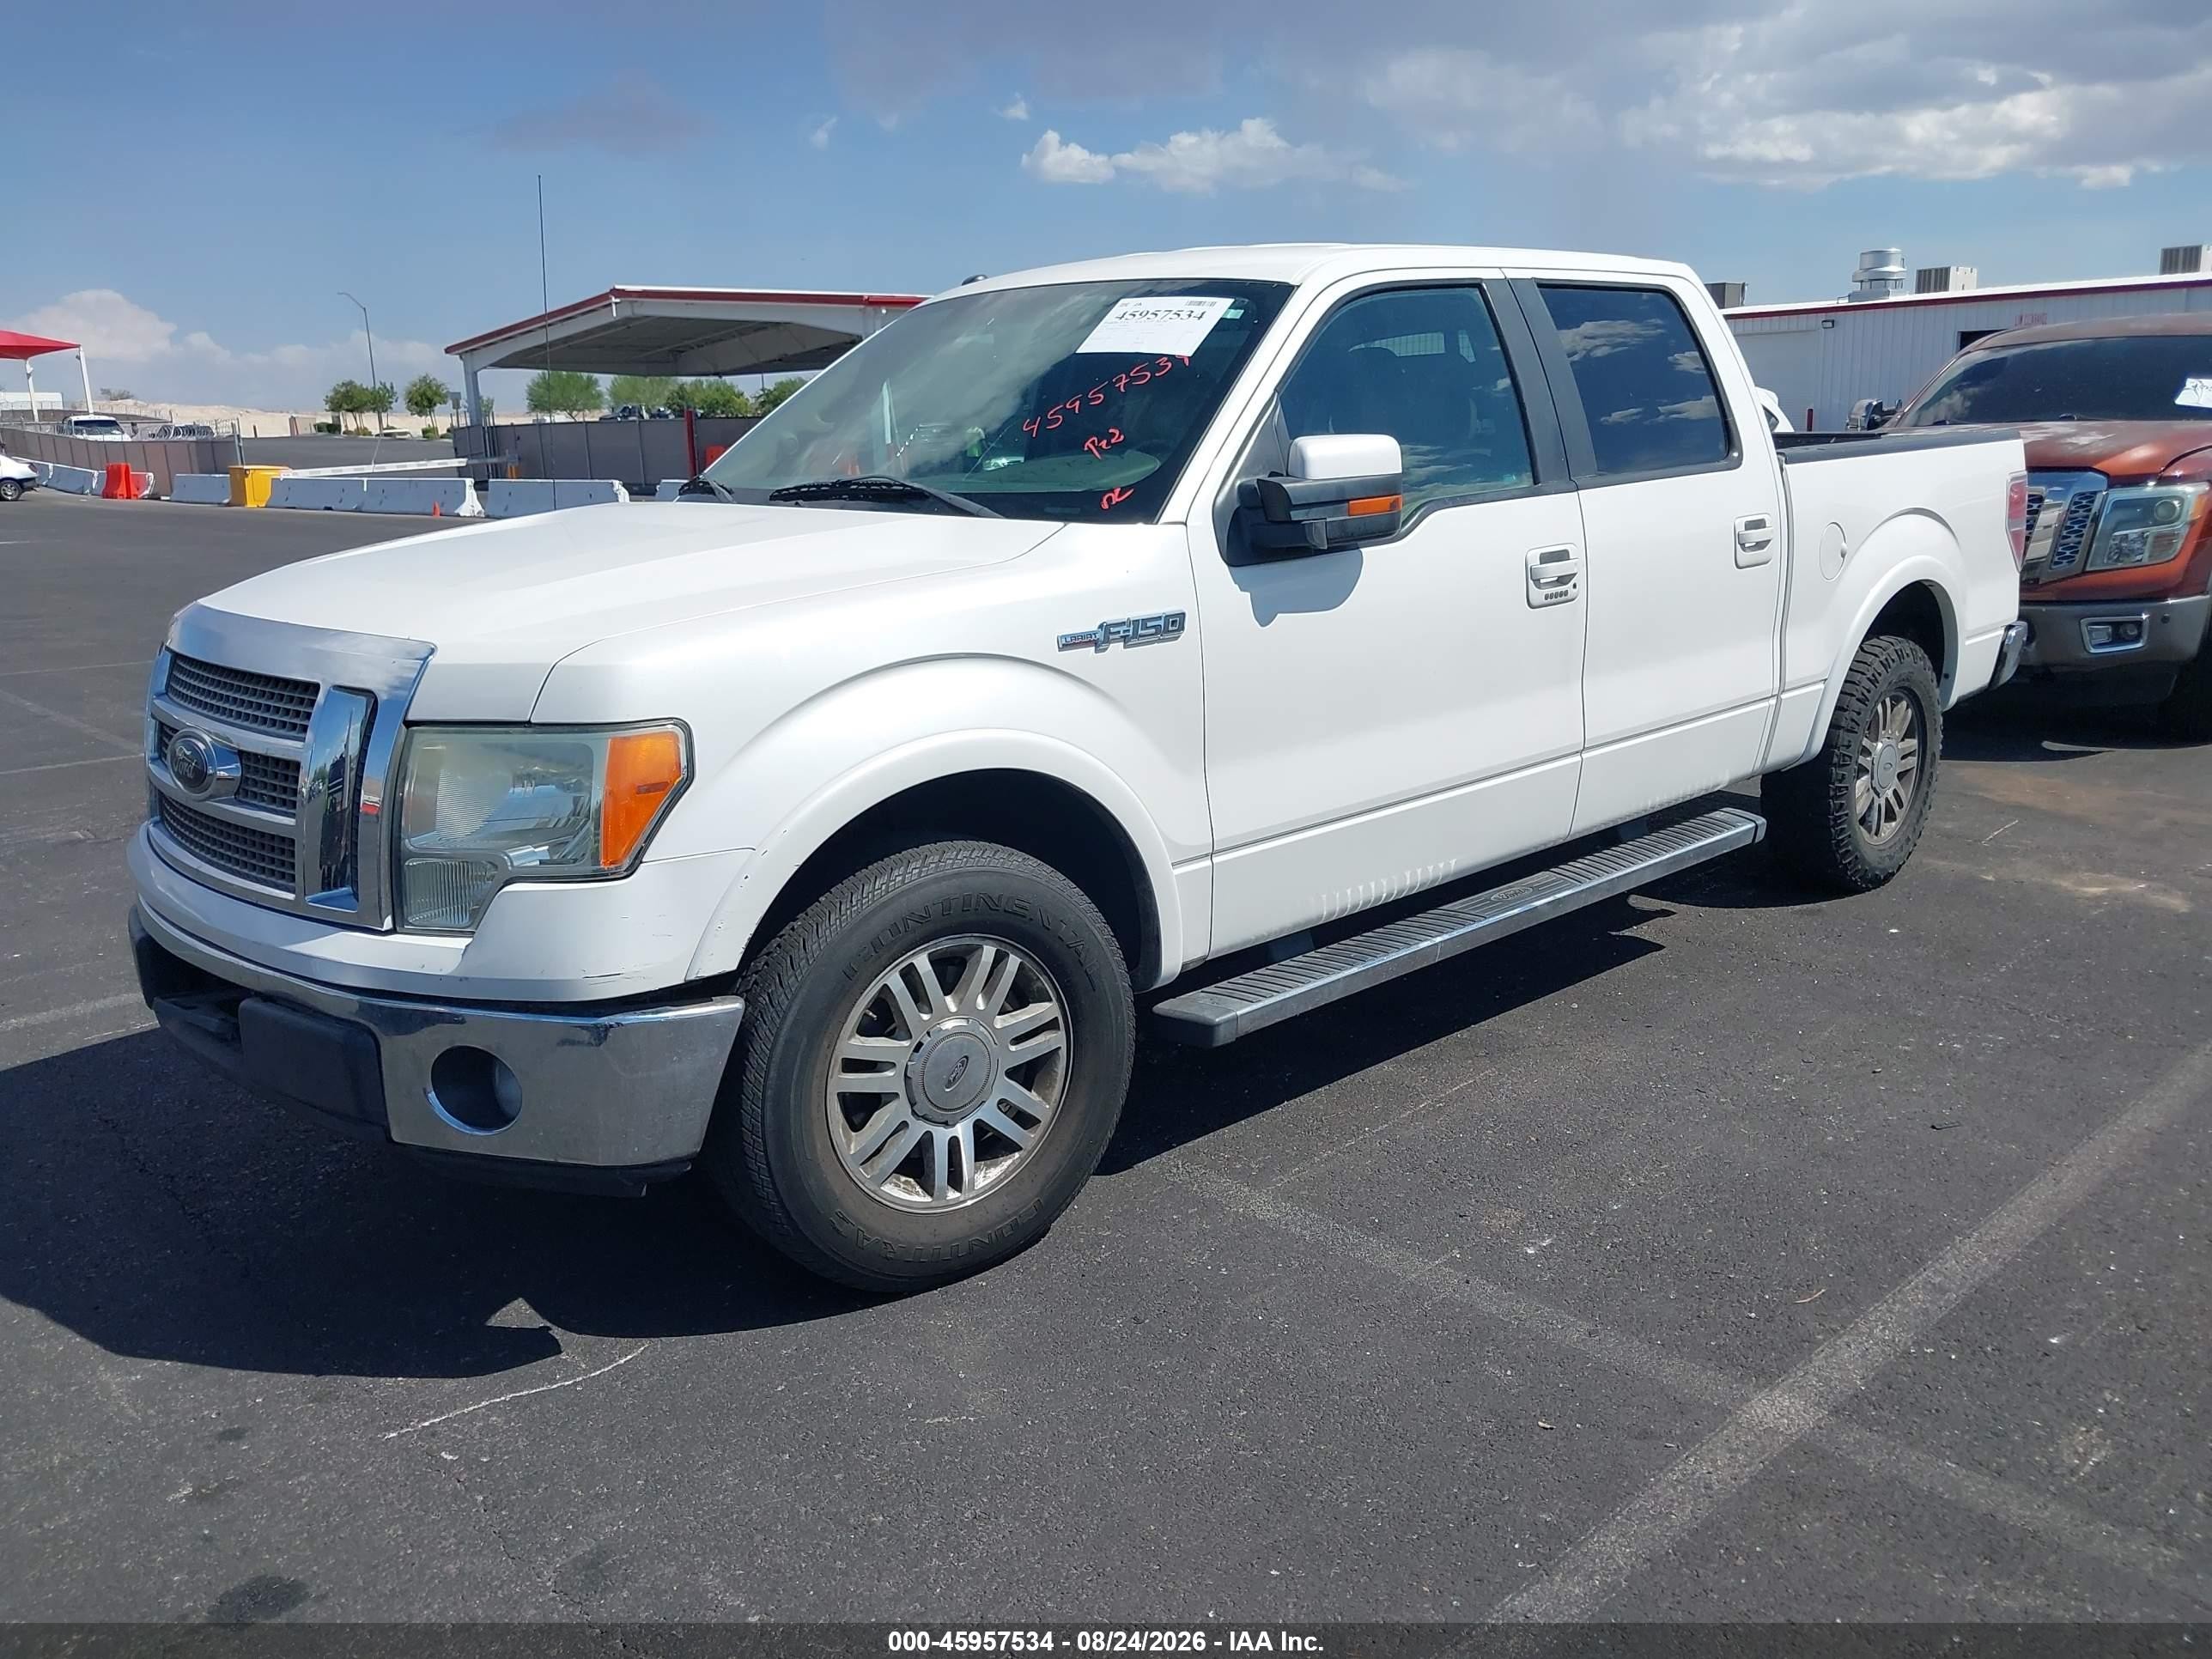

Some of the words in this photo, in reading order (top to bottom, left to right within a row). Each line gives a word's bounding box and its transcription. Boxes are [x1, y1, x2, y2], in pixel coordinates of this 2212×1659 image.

[1115, 310, 1206, 320] 45957534
[1094, 612, 1186, 653] F-150
[173, 745, 200, 779] Ford
